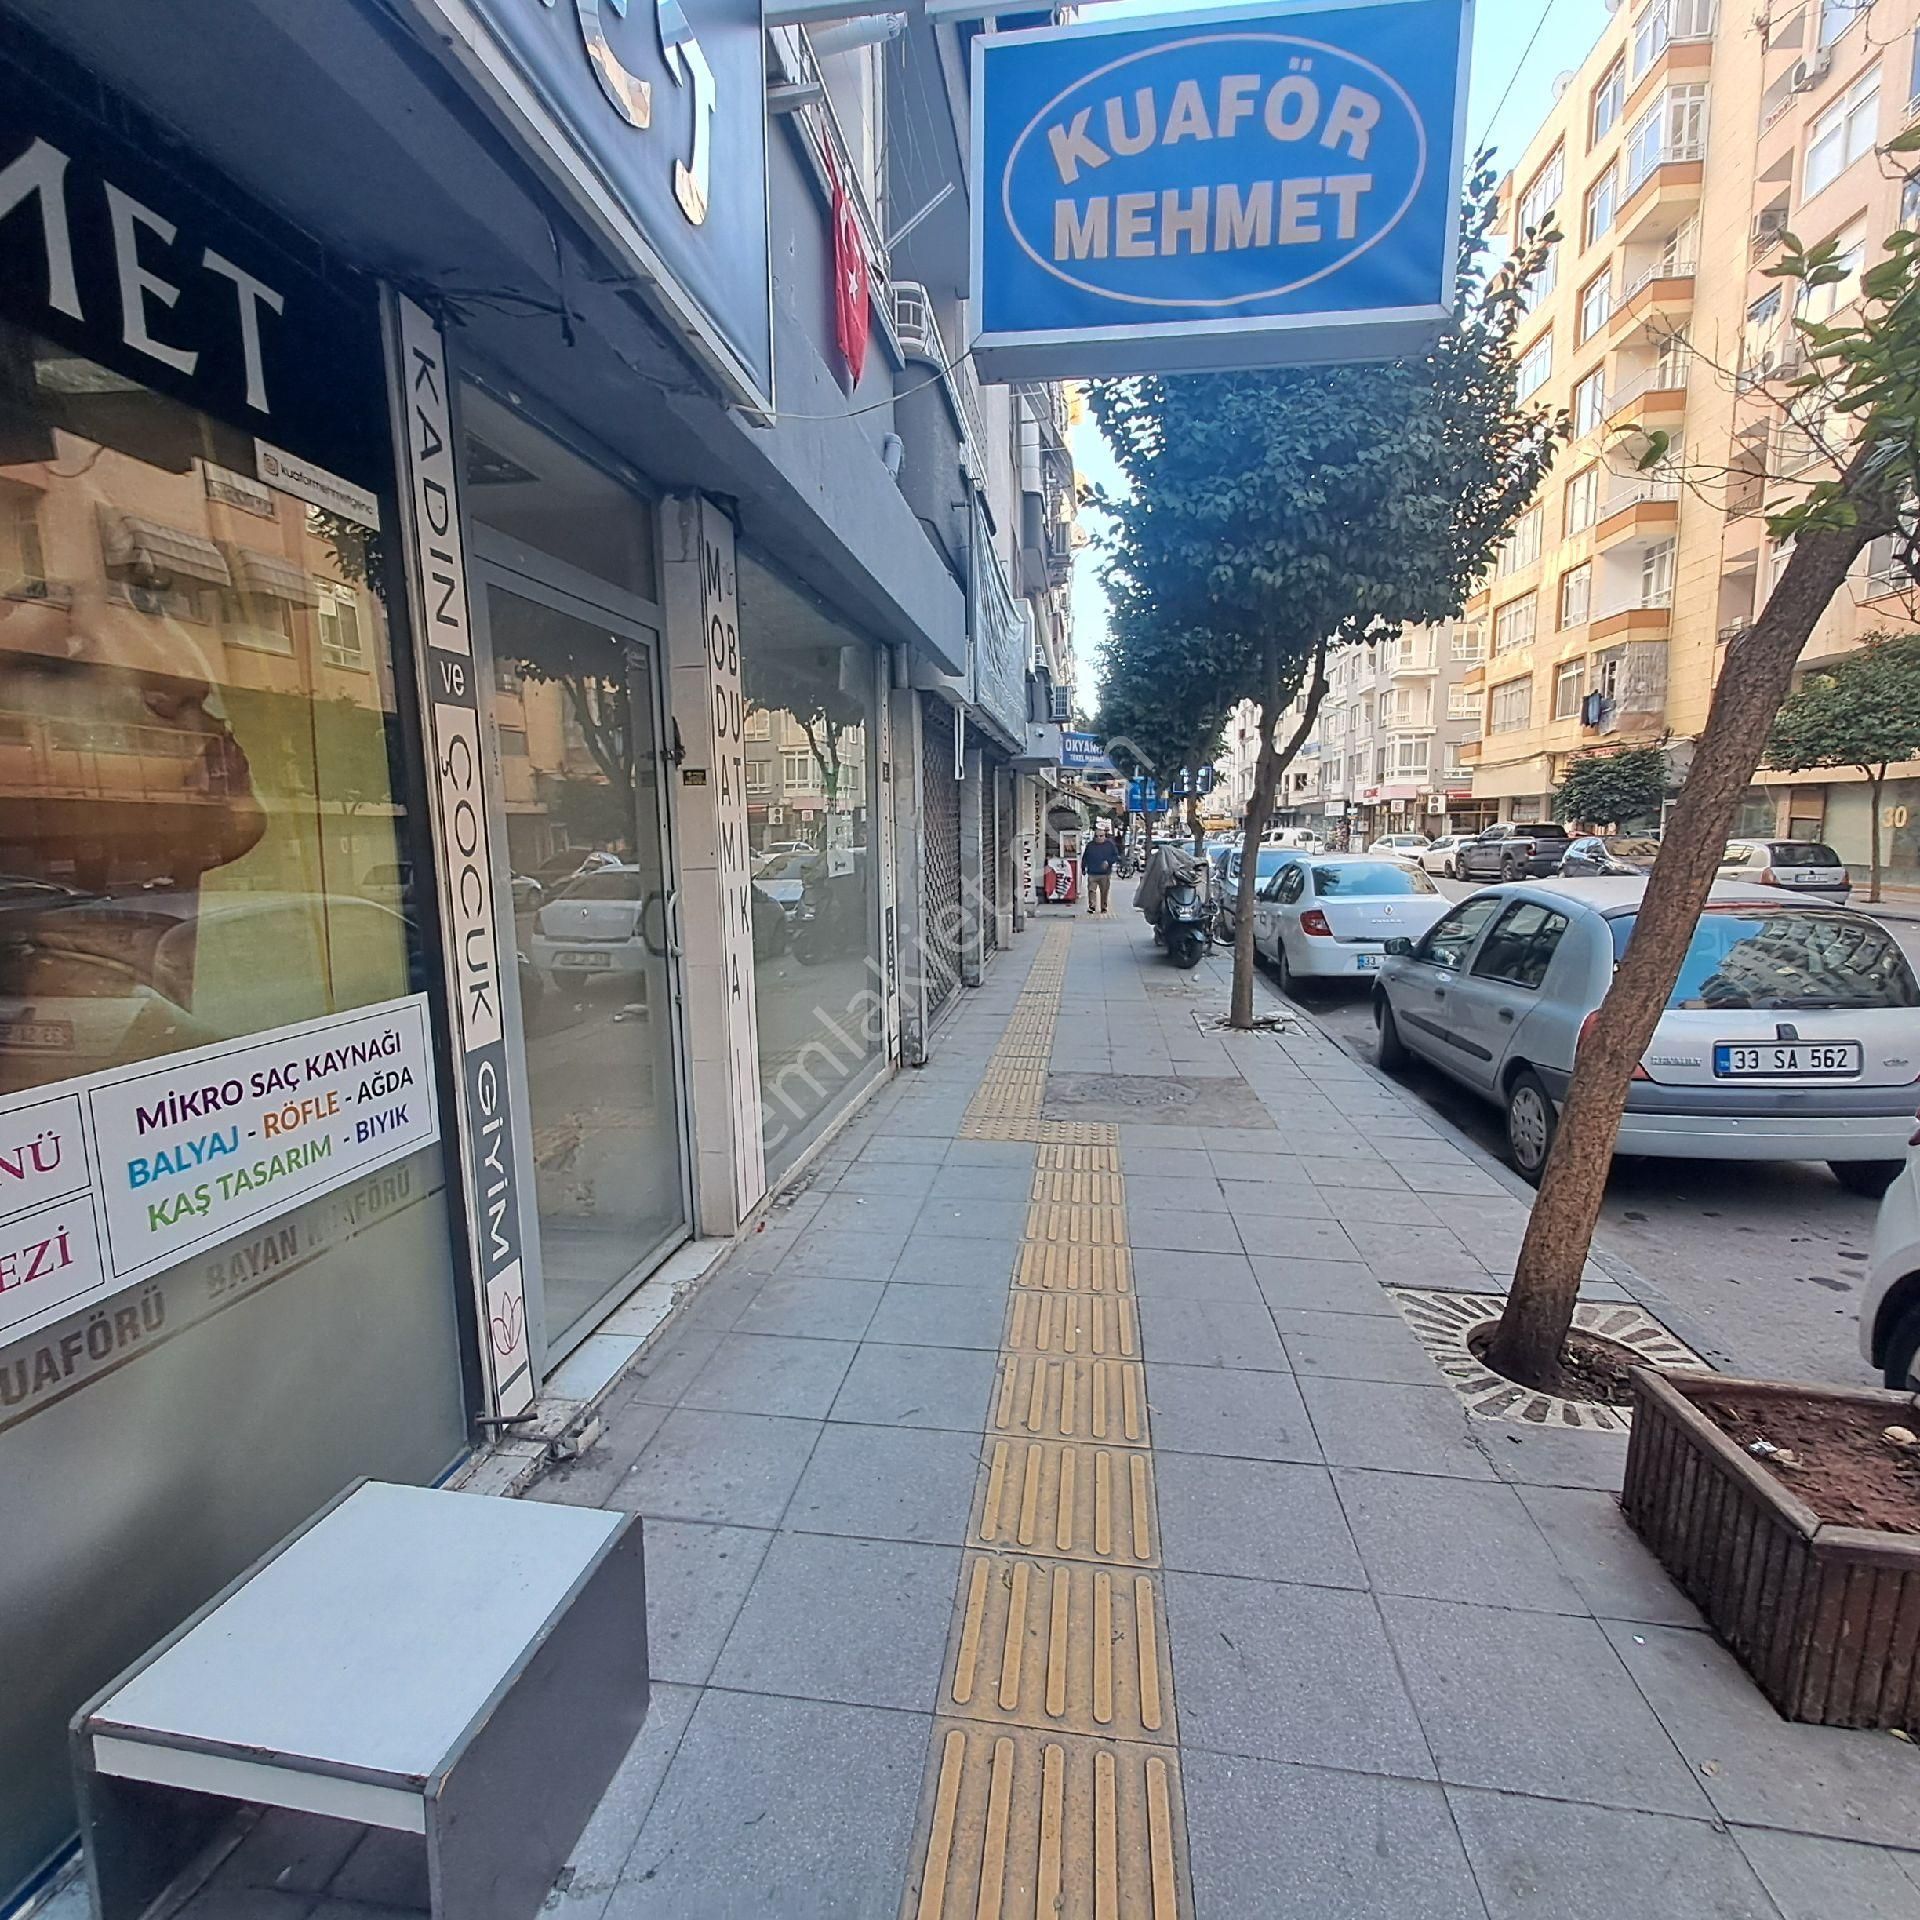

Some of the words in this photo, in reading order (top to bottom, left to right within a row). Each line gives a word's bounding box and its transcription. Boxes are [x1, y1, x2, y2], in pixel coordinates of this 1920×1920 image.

[1048, 57, 1381, 184] KUAFÖR
[1054, 174, 1371, 261] MEHMET
[412, 346, 459, 628] KADIN
[440, 660, 465, 696] ve
[1065, 739, 1104, 754] OKYAN
[1883, 805, 1907, 828] 30
[440, 734, 494, 1024] ÇOCUK
[136, 1080, 243, 1135] MİKRO
[251, 1063, 300, 1098] SAÇ
[305, 1031, 401, 1082] KAYNAĞI
[1734, 1050, 1759, 1069] 33
[1774, 1050, 1798, 1069] SA
[1811, 1049, 1848, 1068] 562
[127, 1126, 240, 1189] BALYAJ
[263, 1090, 341, 1139] RÖFLE
[357, 1066, 414, 1106] AĞDA
[147, 1184, 211, 1232] KAŞ
[215, 1134, 332, 1200] TASARIM
[356, 1103, 410, 1145] BIYIK
[477, 1060, 511, 1262] GİYİM
